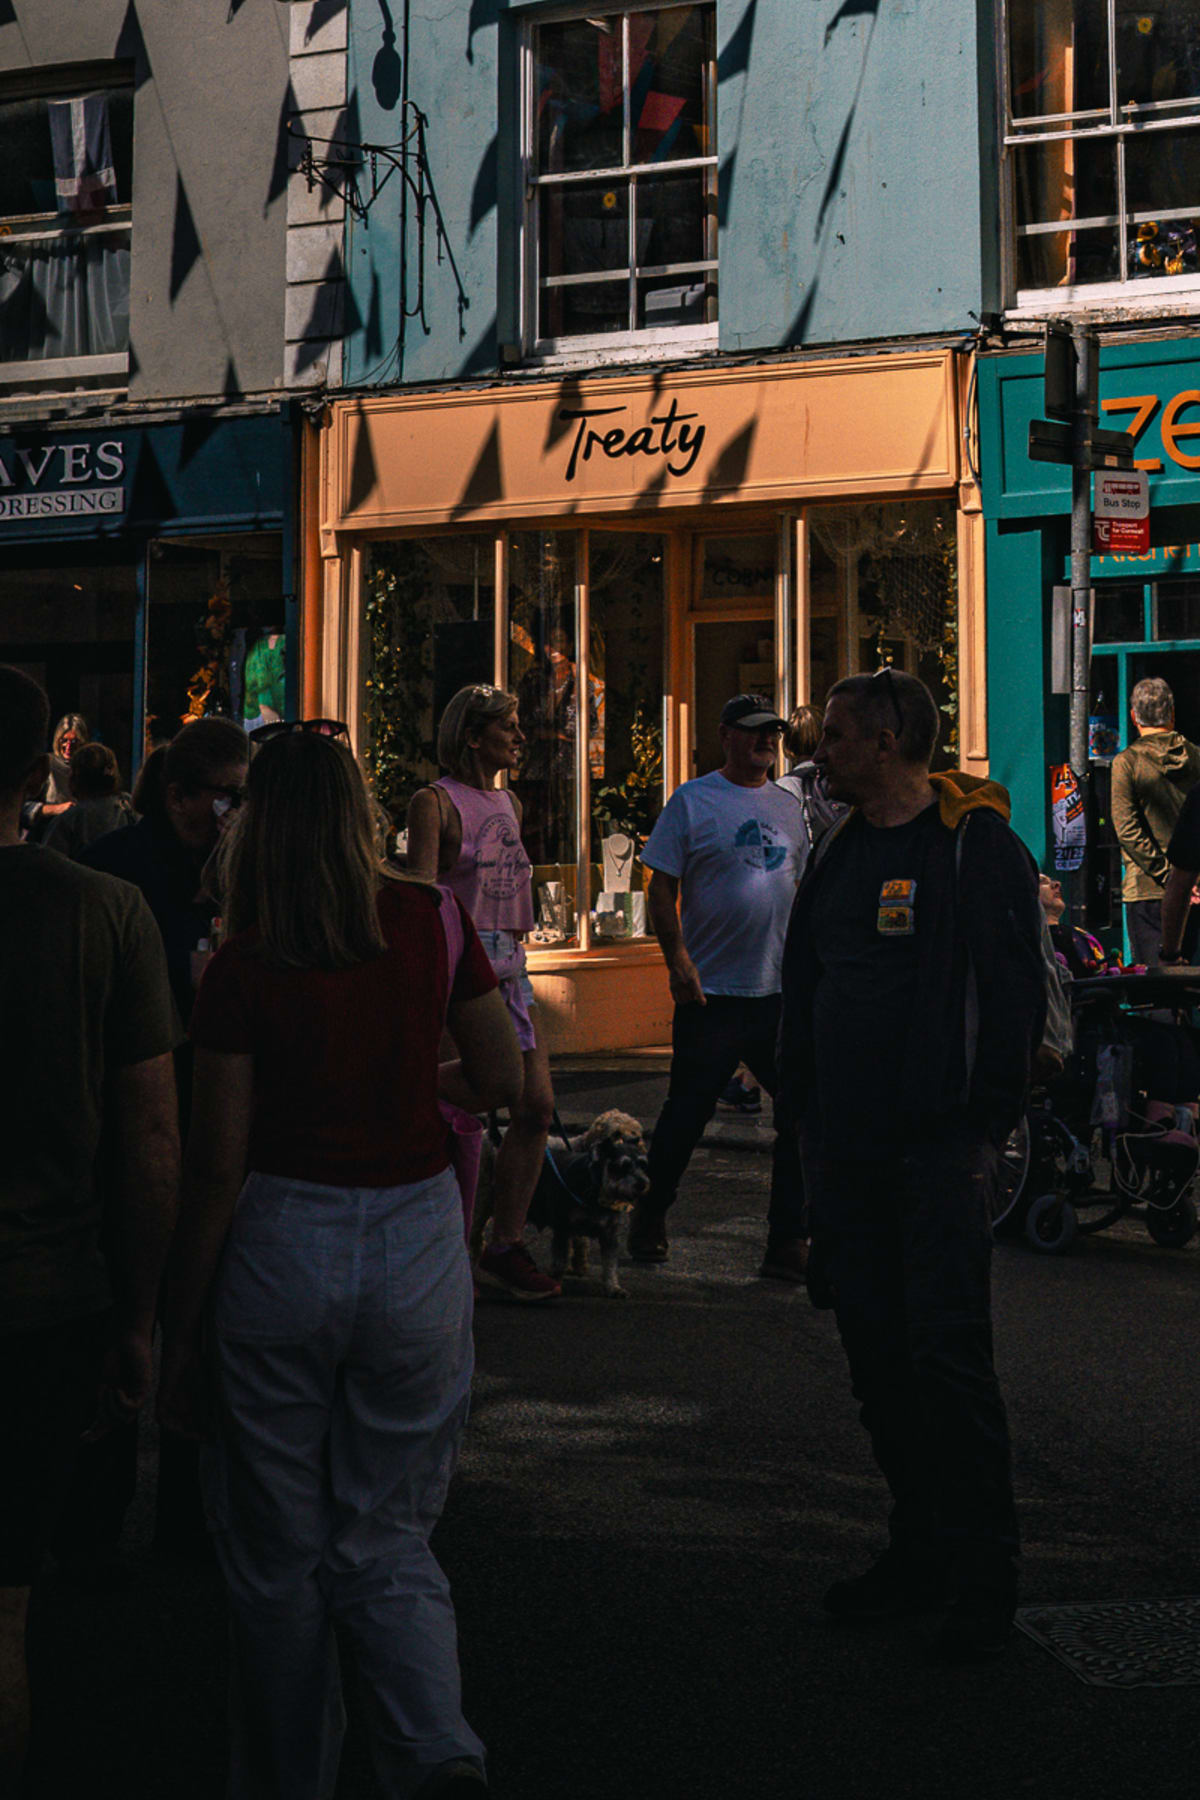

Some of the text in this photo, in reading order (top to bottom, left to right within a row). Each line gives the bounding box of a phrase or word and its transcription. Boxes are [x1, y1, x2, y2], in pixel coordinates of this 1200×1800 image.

[559, 398, 706, 481] Treaty
[1103, 497, 1141, 510] Bus Stop
